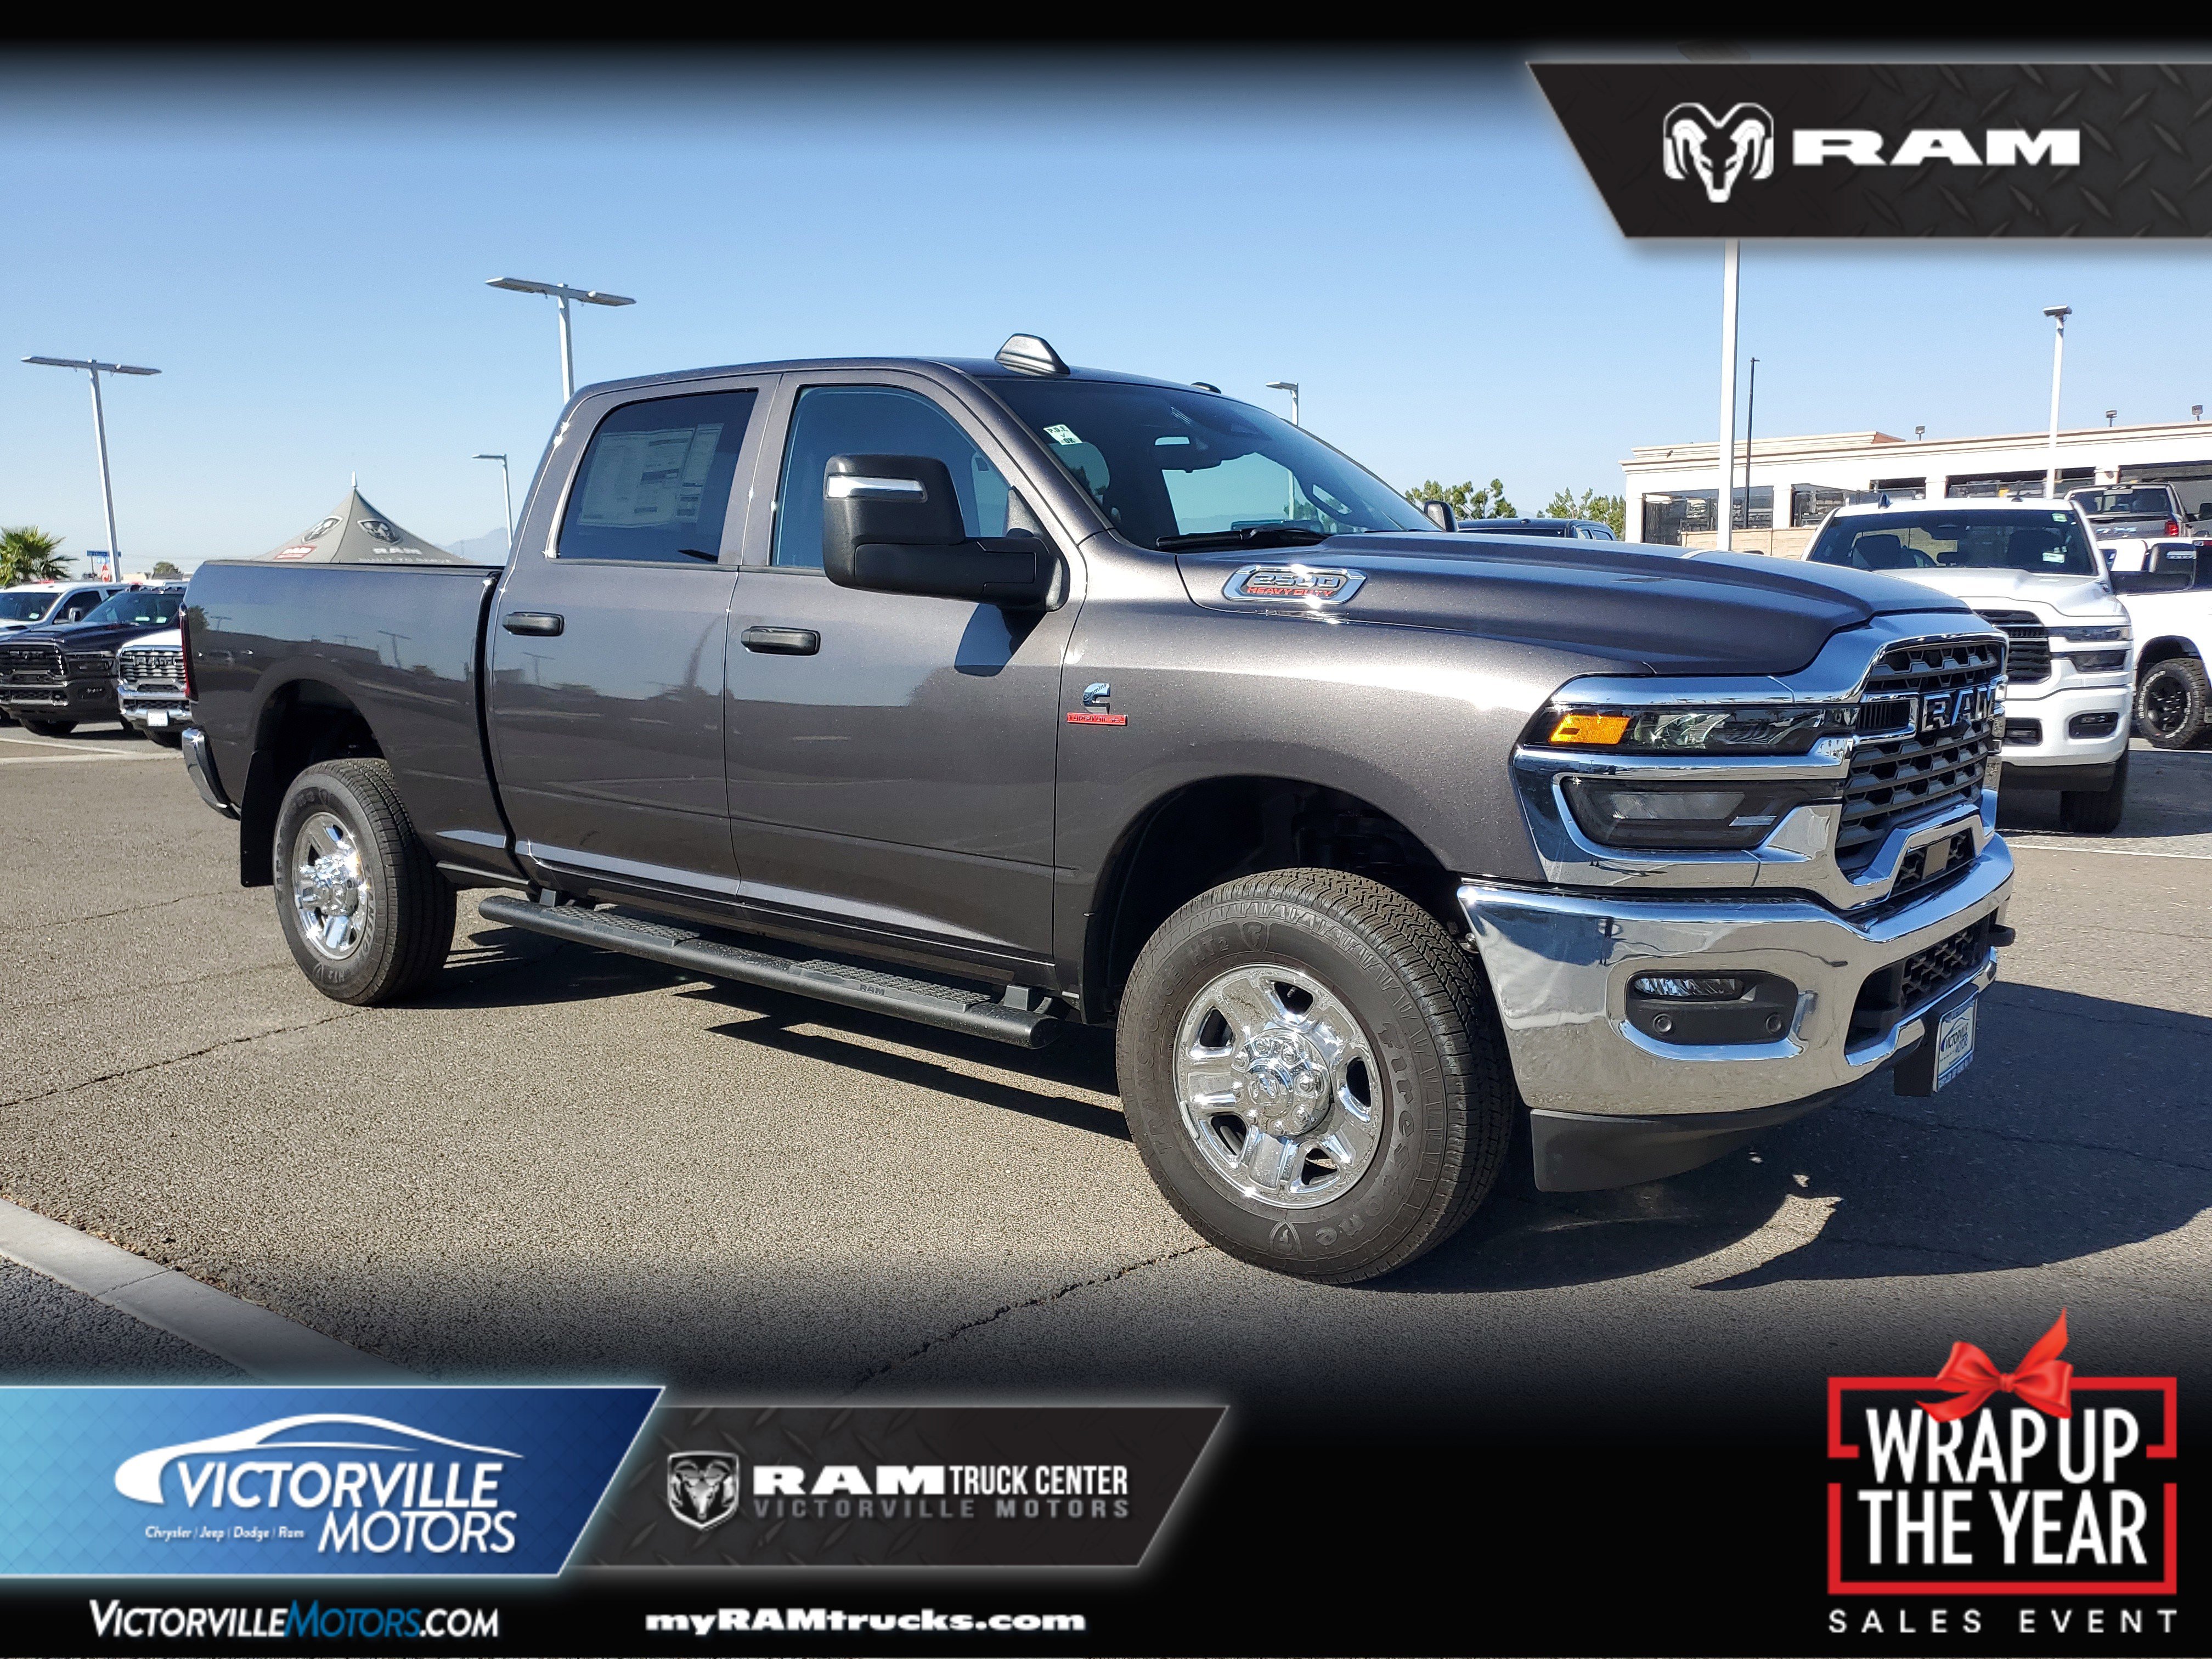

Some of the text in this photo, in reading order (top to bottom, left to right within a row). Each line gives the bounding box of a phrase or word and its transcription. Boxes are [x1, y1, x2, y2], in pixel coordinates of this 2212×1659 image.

[1247, 587, 1292, 596] HEAVY
[1083, 683, 1109, 701] Cummins
[1921, 684, 1996, 733] RAM
[859, 984, 885, 995] RAM
[1316, 1022, 1415, 1246] Firestone
